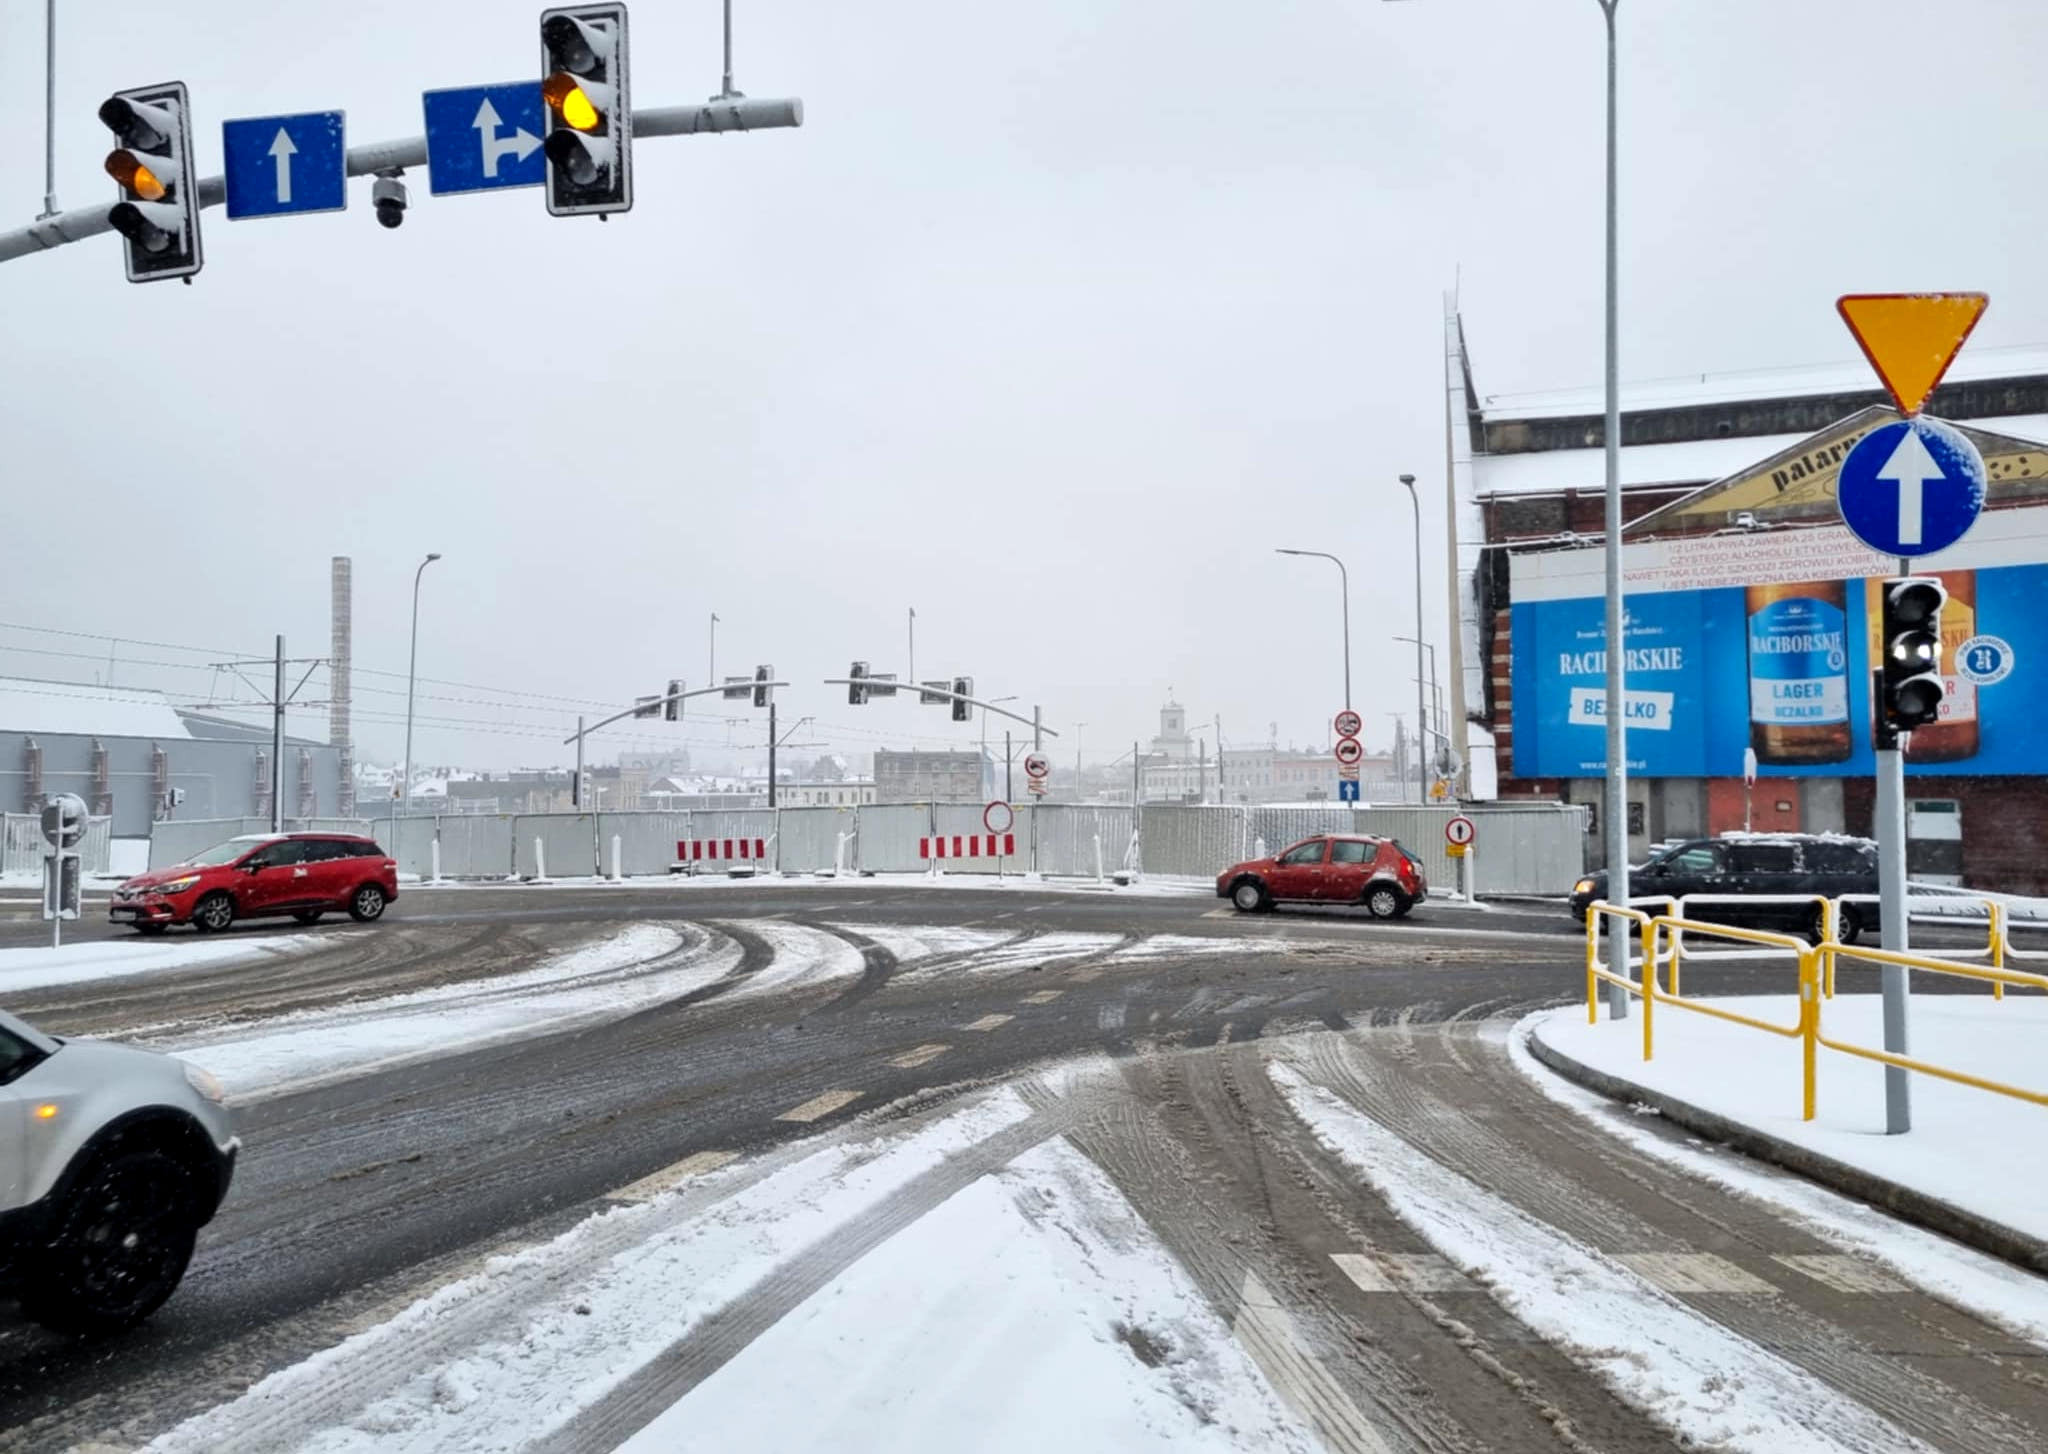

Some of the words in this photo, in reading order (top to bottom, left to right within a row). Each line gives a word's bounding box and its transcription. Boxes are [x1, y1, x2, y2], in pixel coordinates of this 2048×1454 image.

[1732, 546, 1792, 559] ALKOHOLU
[1777, 556, 1834, 570] ZDROWIU
[1560, 647, 1683, 675] RACIRSKIE
[1773, 682, 1824, 699] LAGER
[1583, 699, 1657, 719] BELKO
